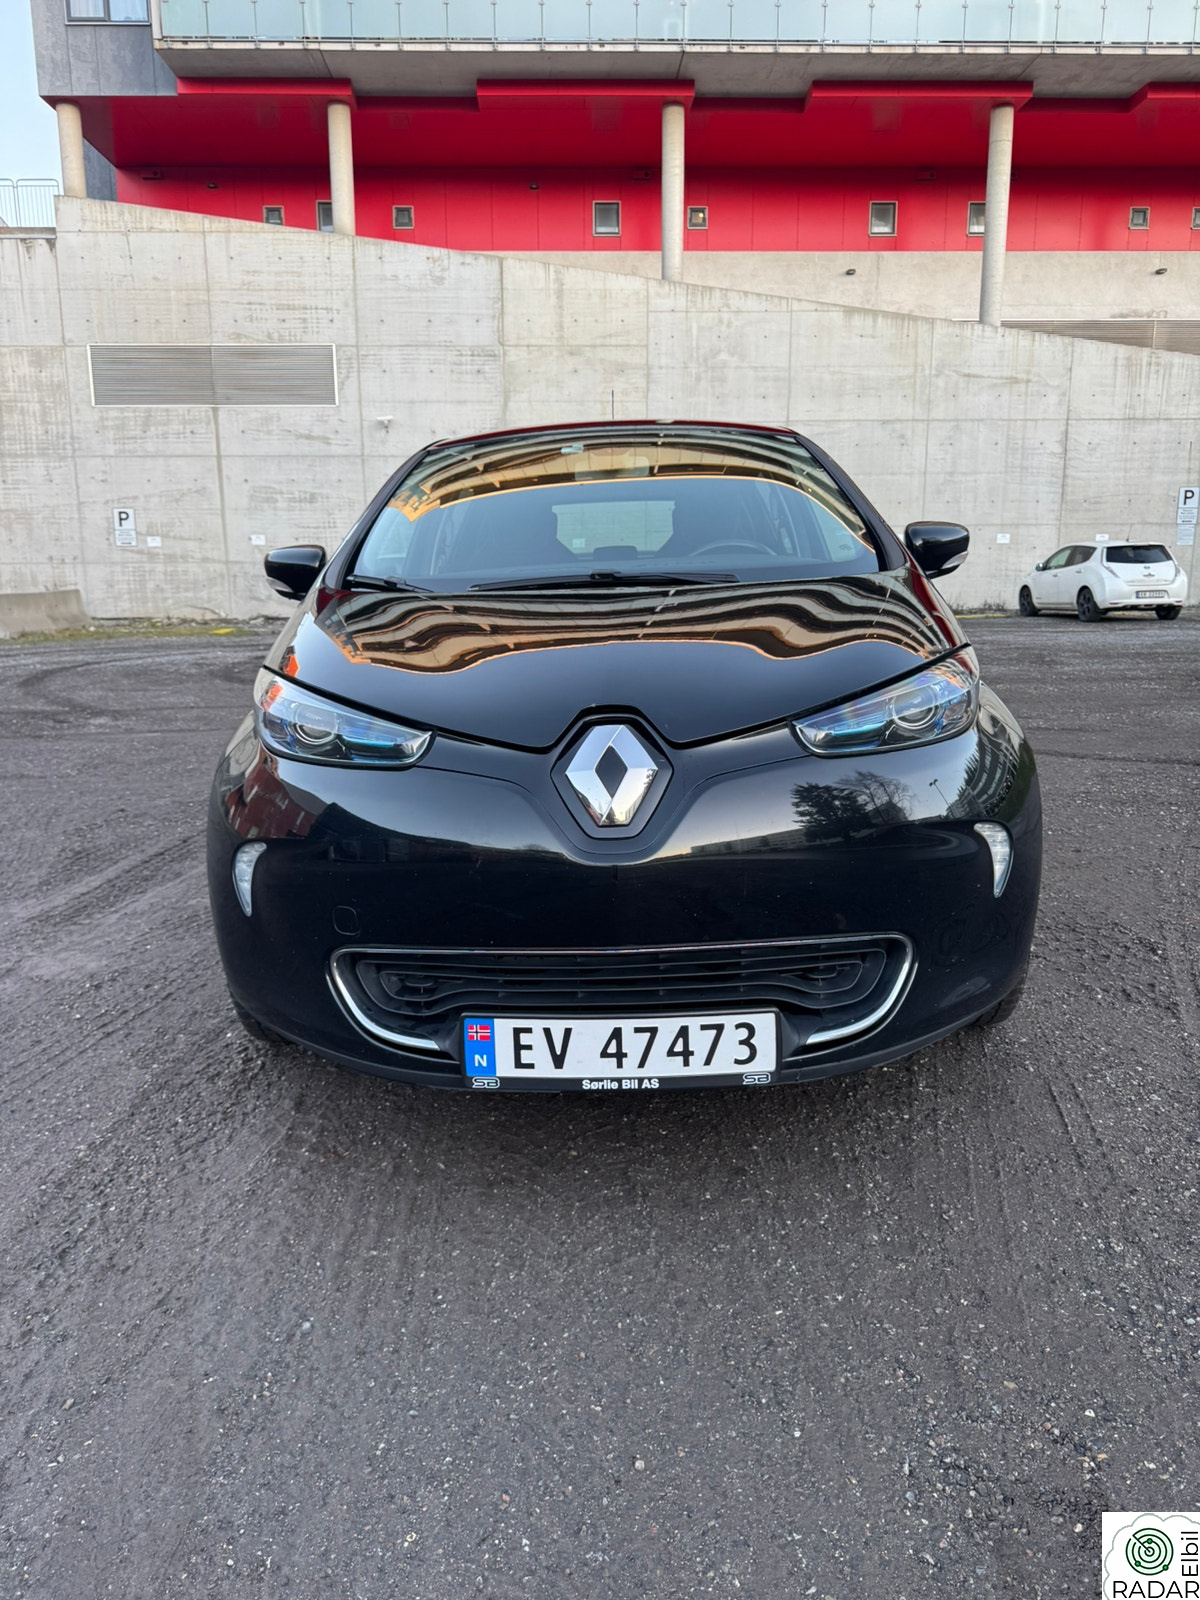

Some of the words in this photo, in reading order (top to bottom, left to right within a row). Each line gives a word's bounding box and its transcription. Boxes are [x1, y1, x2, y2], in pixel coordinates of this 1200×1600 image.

[1183, 489, 1195, 506] P
[118, 511, 129, 527] P
[512, 1026, 573, 1069] EV
[600, 1021, 758, 1069] 47473
[474, 1054, 487, 1067] N
[622, 1079, 638, 1089] Bil
[641, 1078, 660, 1089] AS
